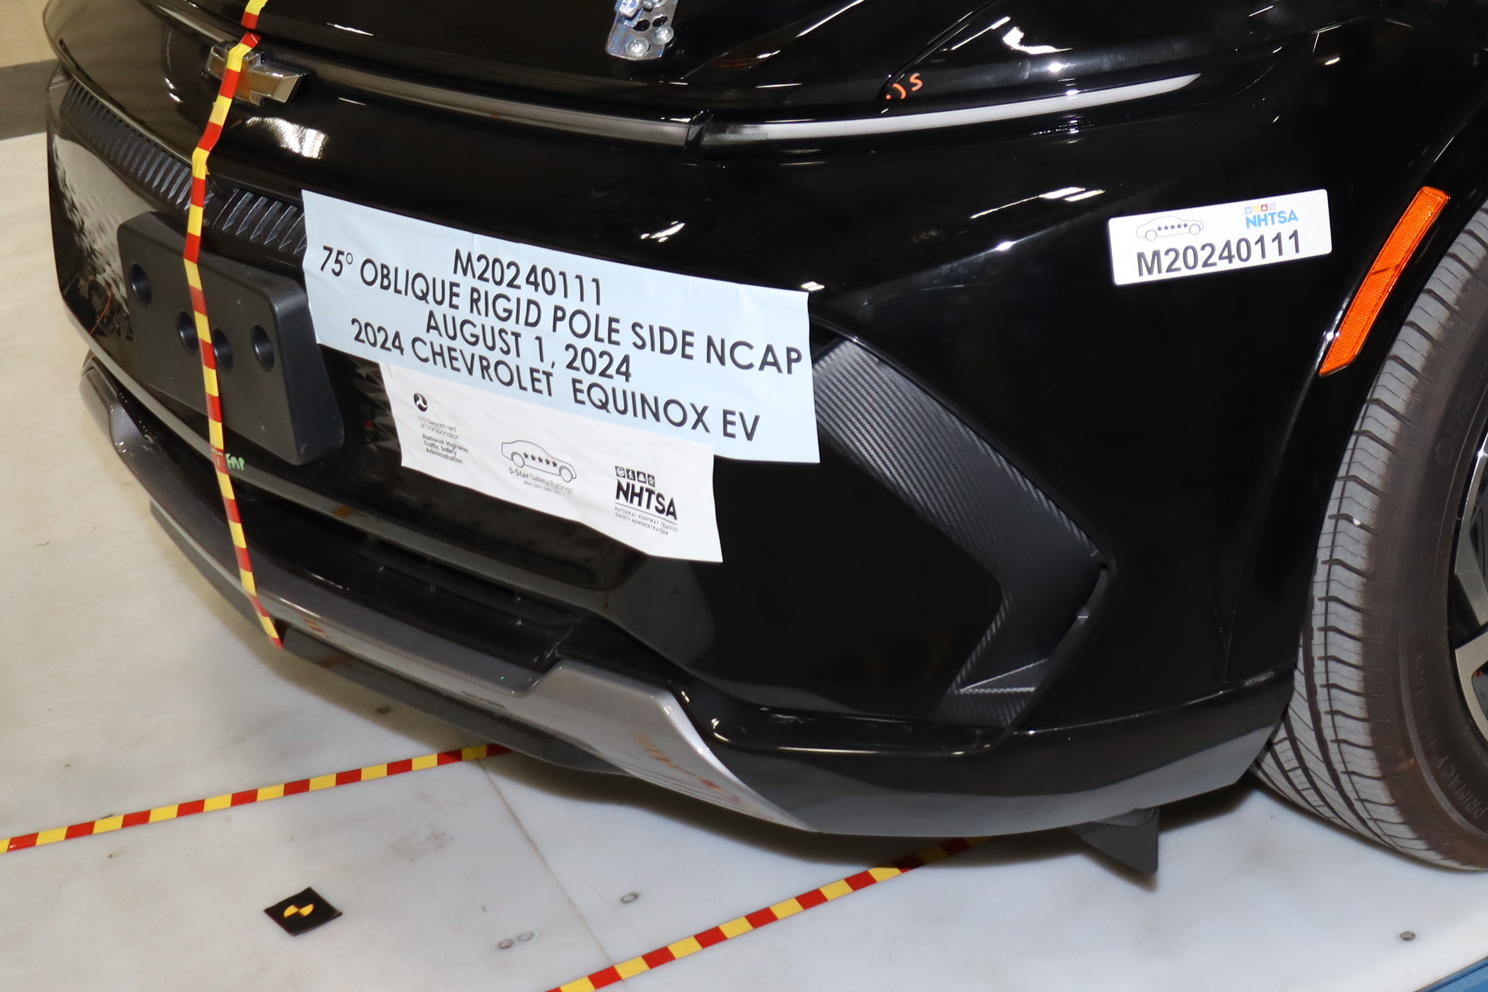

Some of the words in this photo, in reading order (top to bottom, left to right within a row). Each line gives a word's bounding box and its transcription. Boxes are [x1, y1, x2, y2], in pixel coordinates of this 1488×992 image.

[1245, 209, 1299, 229] NHTSA
[453, 248, 601, 306] M20240111
[1136, 229, 1301, 277] M20240111
[360, 258, 461, 310] OBLIQUE
[469, 286, 542, 328] RIGID
[552, 304, 621, 346] POLE
[631, 322, 695, 360] SIDE
[706, 334, 803, 375] NCAP
[425, 310, 522, 358] AUGUST
[534, 336, 556, 369] 1,
[564, 343, 632, 383] 2024
[351, 318, 405, 356] 2024
[411, 336, 553, 397] CHEVROLET
[571, 377, 711, 433] EQUINOX
[722, 408, 761, 441] EV
[615, 479, 678, 521] NHTSA
